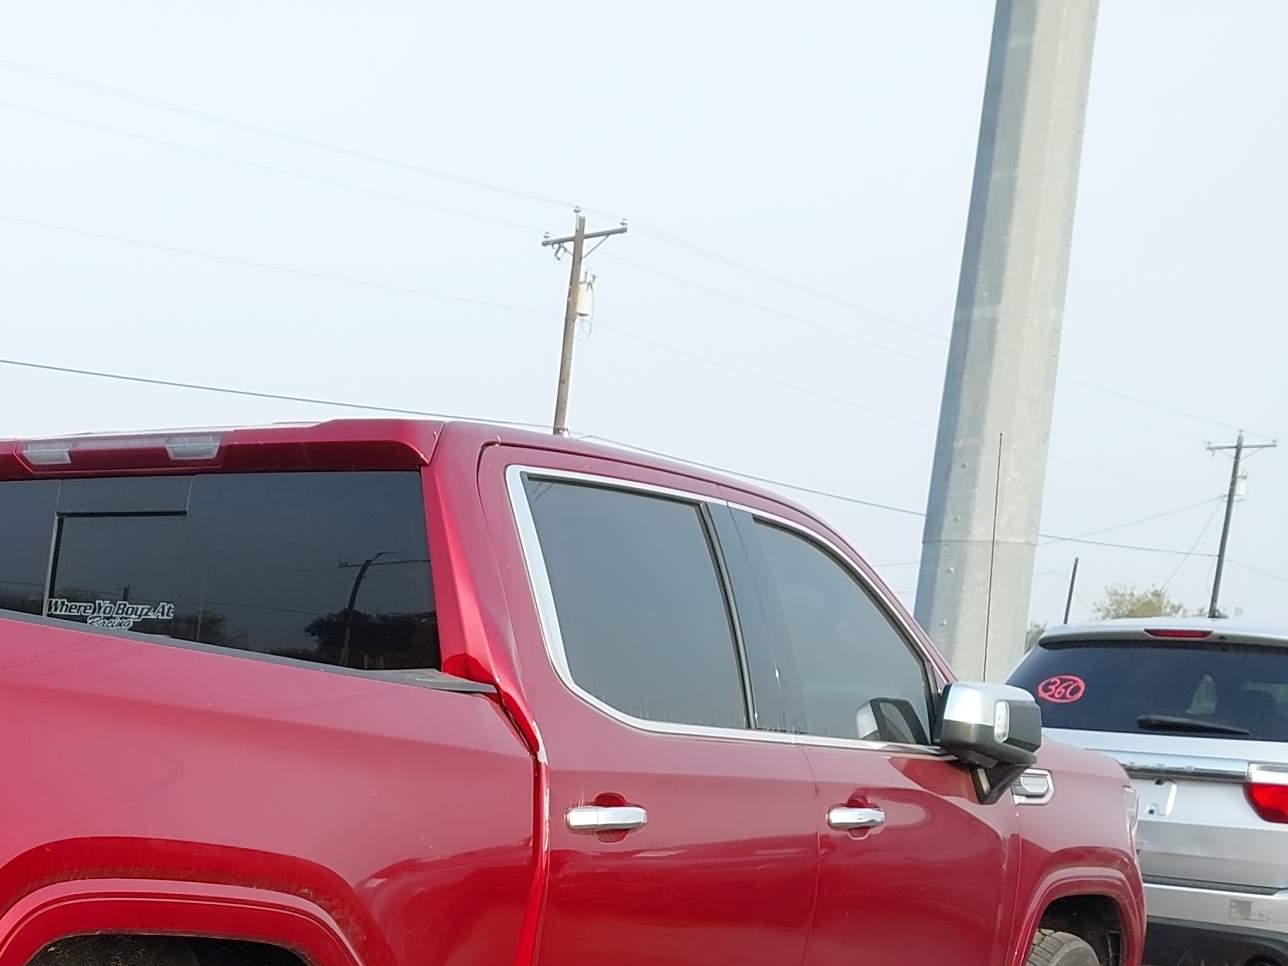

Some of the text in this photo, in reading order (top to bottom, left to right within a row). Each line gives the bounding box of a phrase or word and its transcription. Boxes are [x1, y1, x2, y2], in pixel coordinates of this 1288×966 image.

[48, 599, 175, 619] Where Yo Boyz At
[87, 614, 132, 631] Racing
